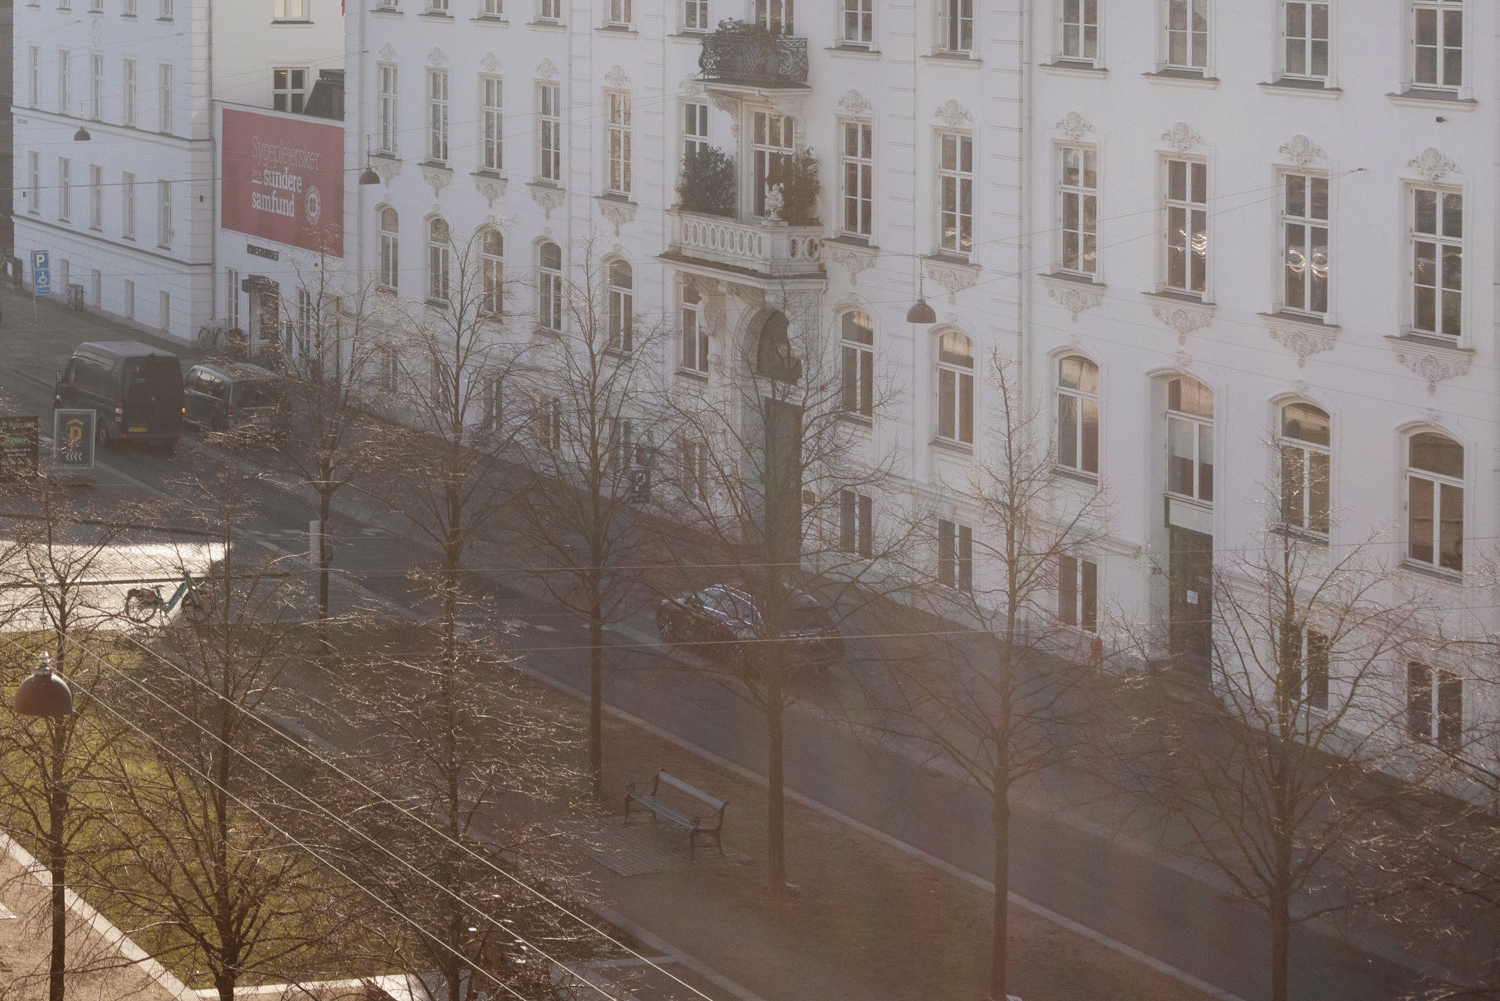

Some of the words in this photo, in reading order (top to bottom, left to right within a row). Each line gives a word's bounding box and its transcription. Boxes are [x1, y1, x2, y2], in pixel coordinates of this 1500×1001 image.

[263, 166, 303, 194] sundere
[252, 190, 296, 218] samfund
[36, 254, 45, 267] P
